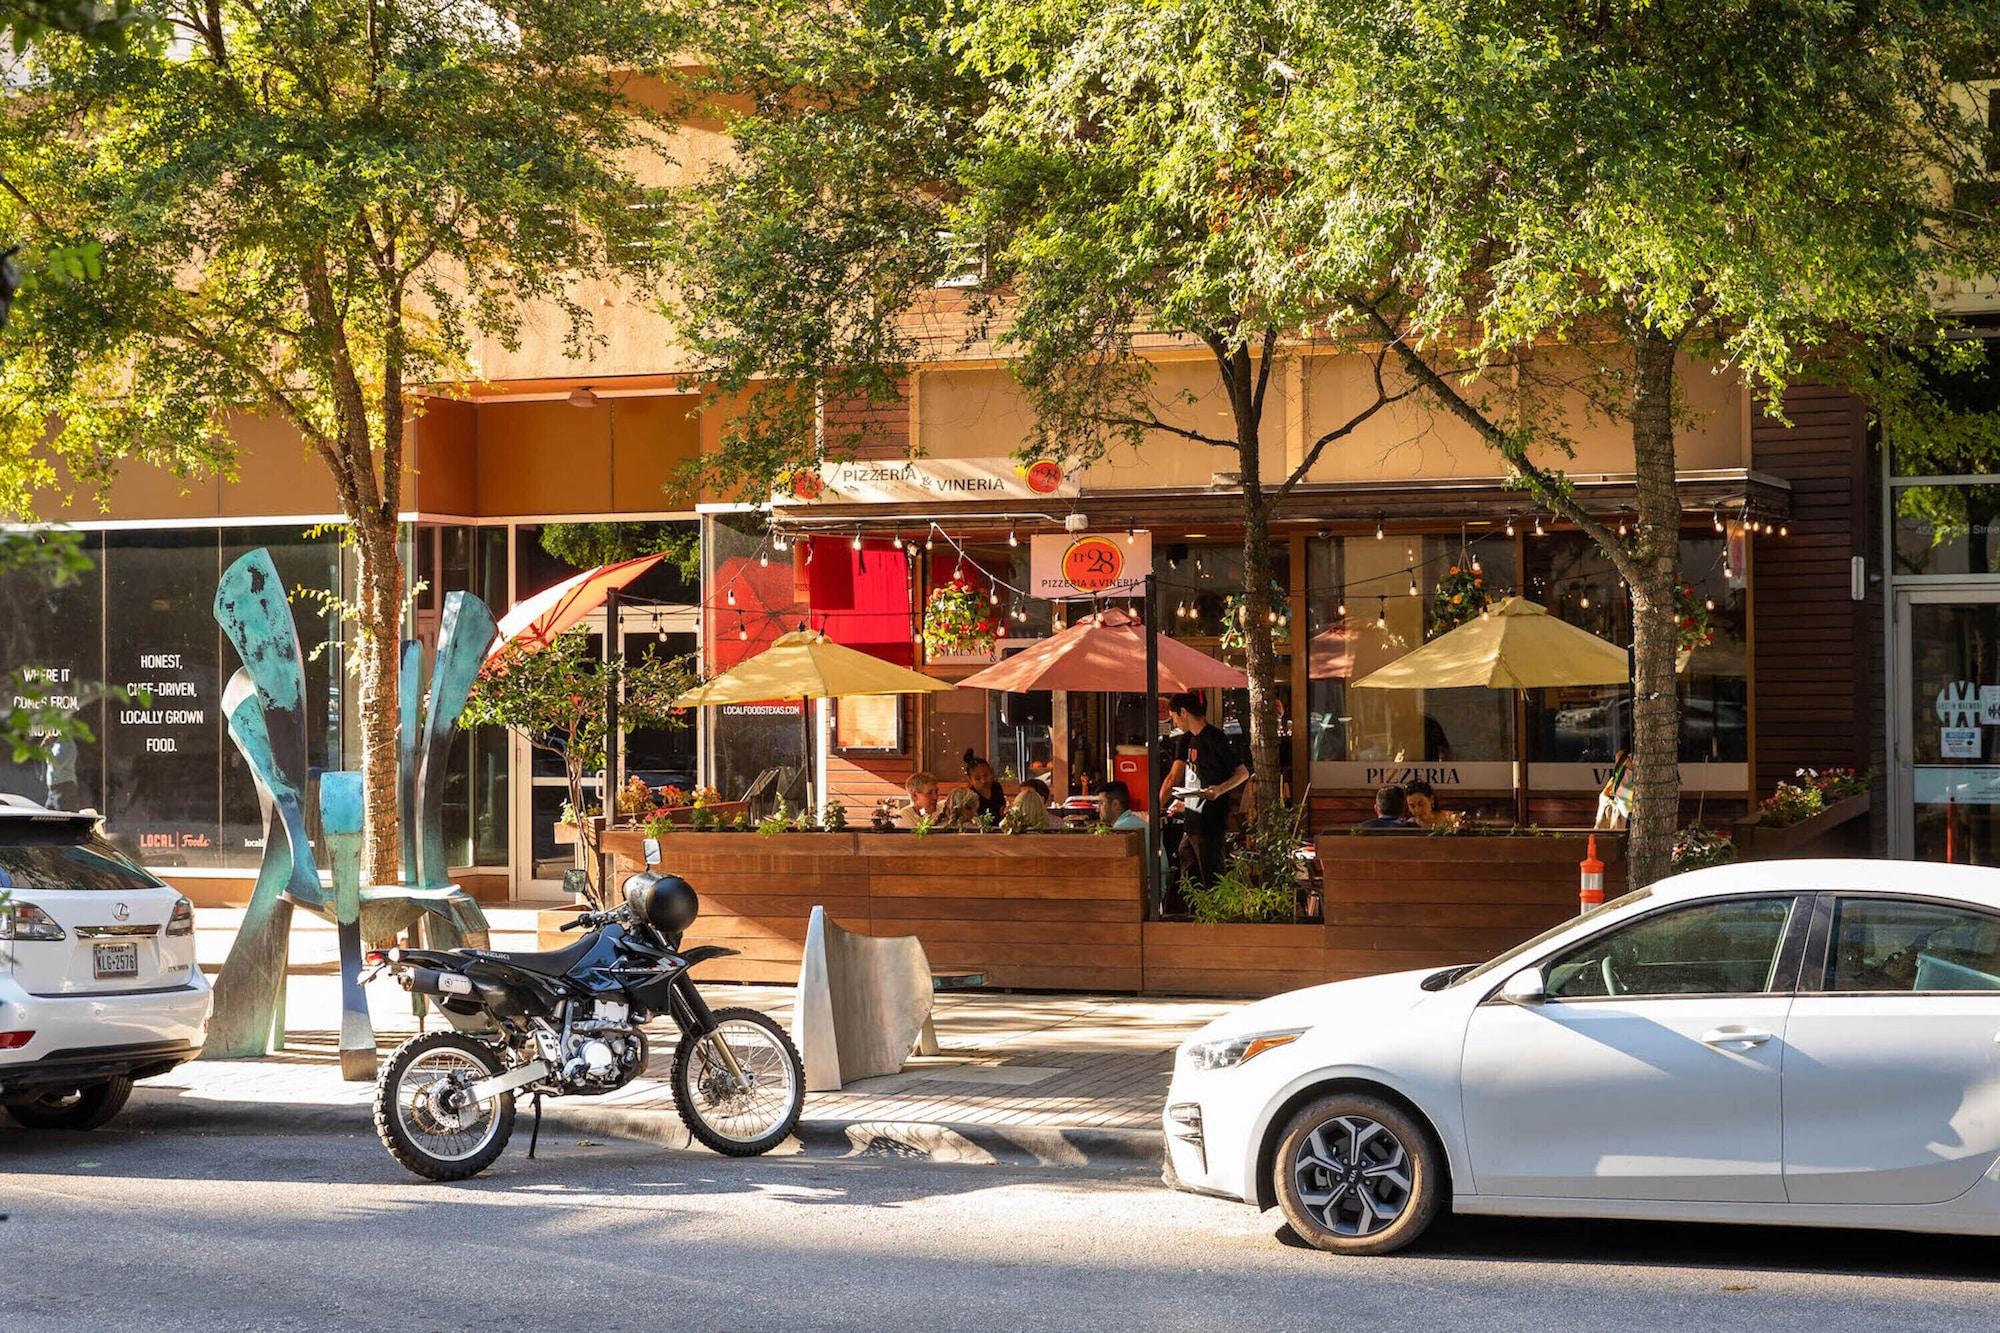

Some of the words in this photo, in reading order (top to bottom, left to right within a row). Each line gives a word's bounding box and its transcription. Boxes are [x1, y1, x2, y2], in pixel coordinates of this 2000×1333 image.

[843, 468, 917, 481] PIZZERIA
[921, 476, 932, 487] &
[937, 478, 1005, 491] VINERIA
[1972, 524, 2000, 534] Stree
[1041, 579, 1087, 588] PIZZERIA
[1090, 580, 1096, 588] &
[1098, 578, 1140, 588] VINERIA
[140, 654, 183, 670] HONEST,
[23, 668, 59, 682] WHERE
[61, 668, 71, 682] IT
[127, 682, 198, 698] CHEF-DRIVEN,
[50, 695, 80, 711] FROM,
[722, 705, 800, 715] LOCALFOODSTEXAS.COM
[120, 710, 164, 724] LOCALLY
[165, 710, 204, 724] GROWN
[146, 738, 178, 752] FOOD.
[1366, 768, 1461, 784] PIZZERIA
[139, 833, 175, 848] LOCAL
[181, 834, 212, 849] Foods
